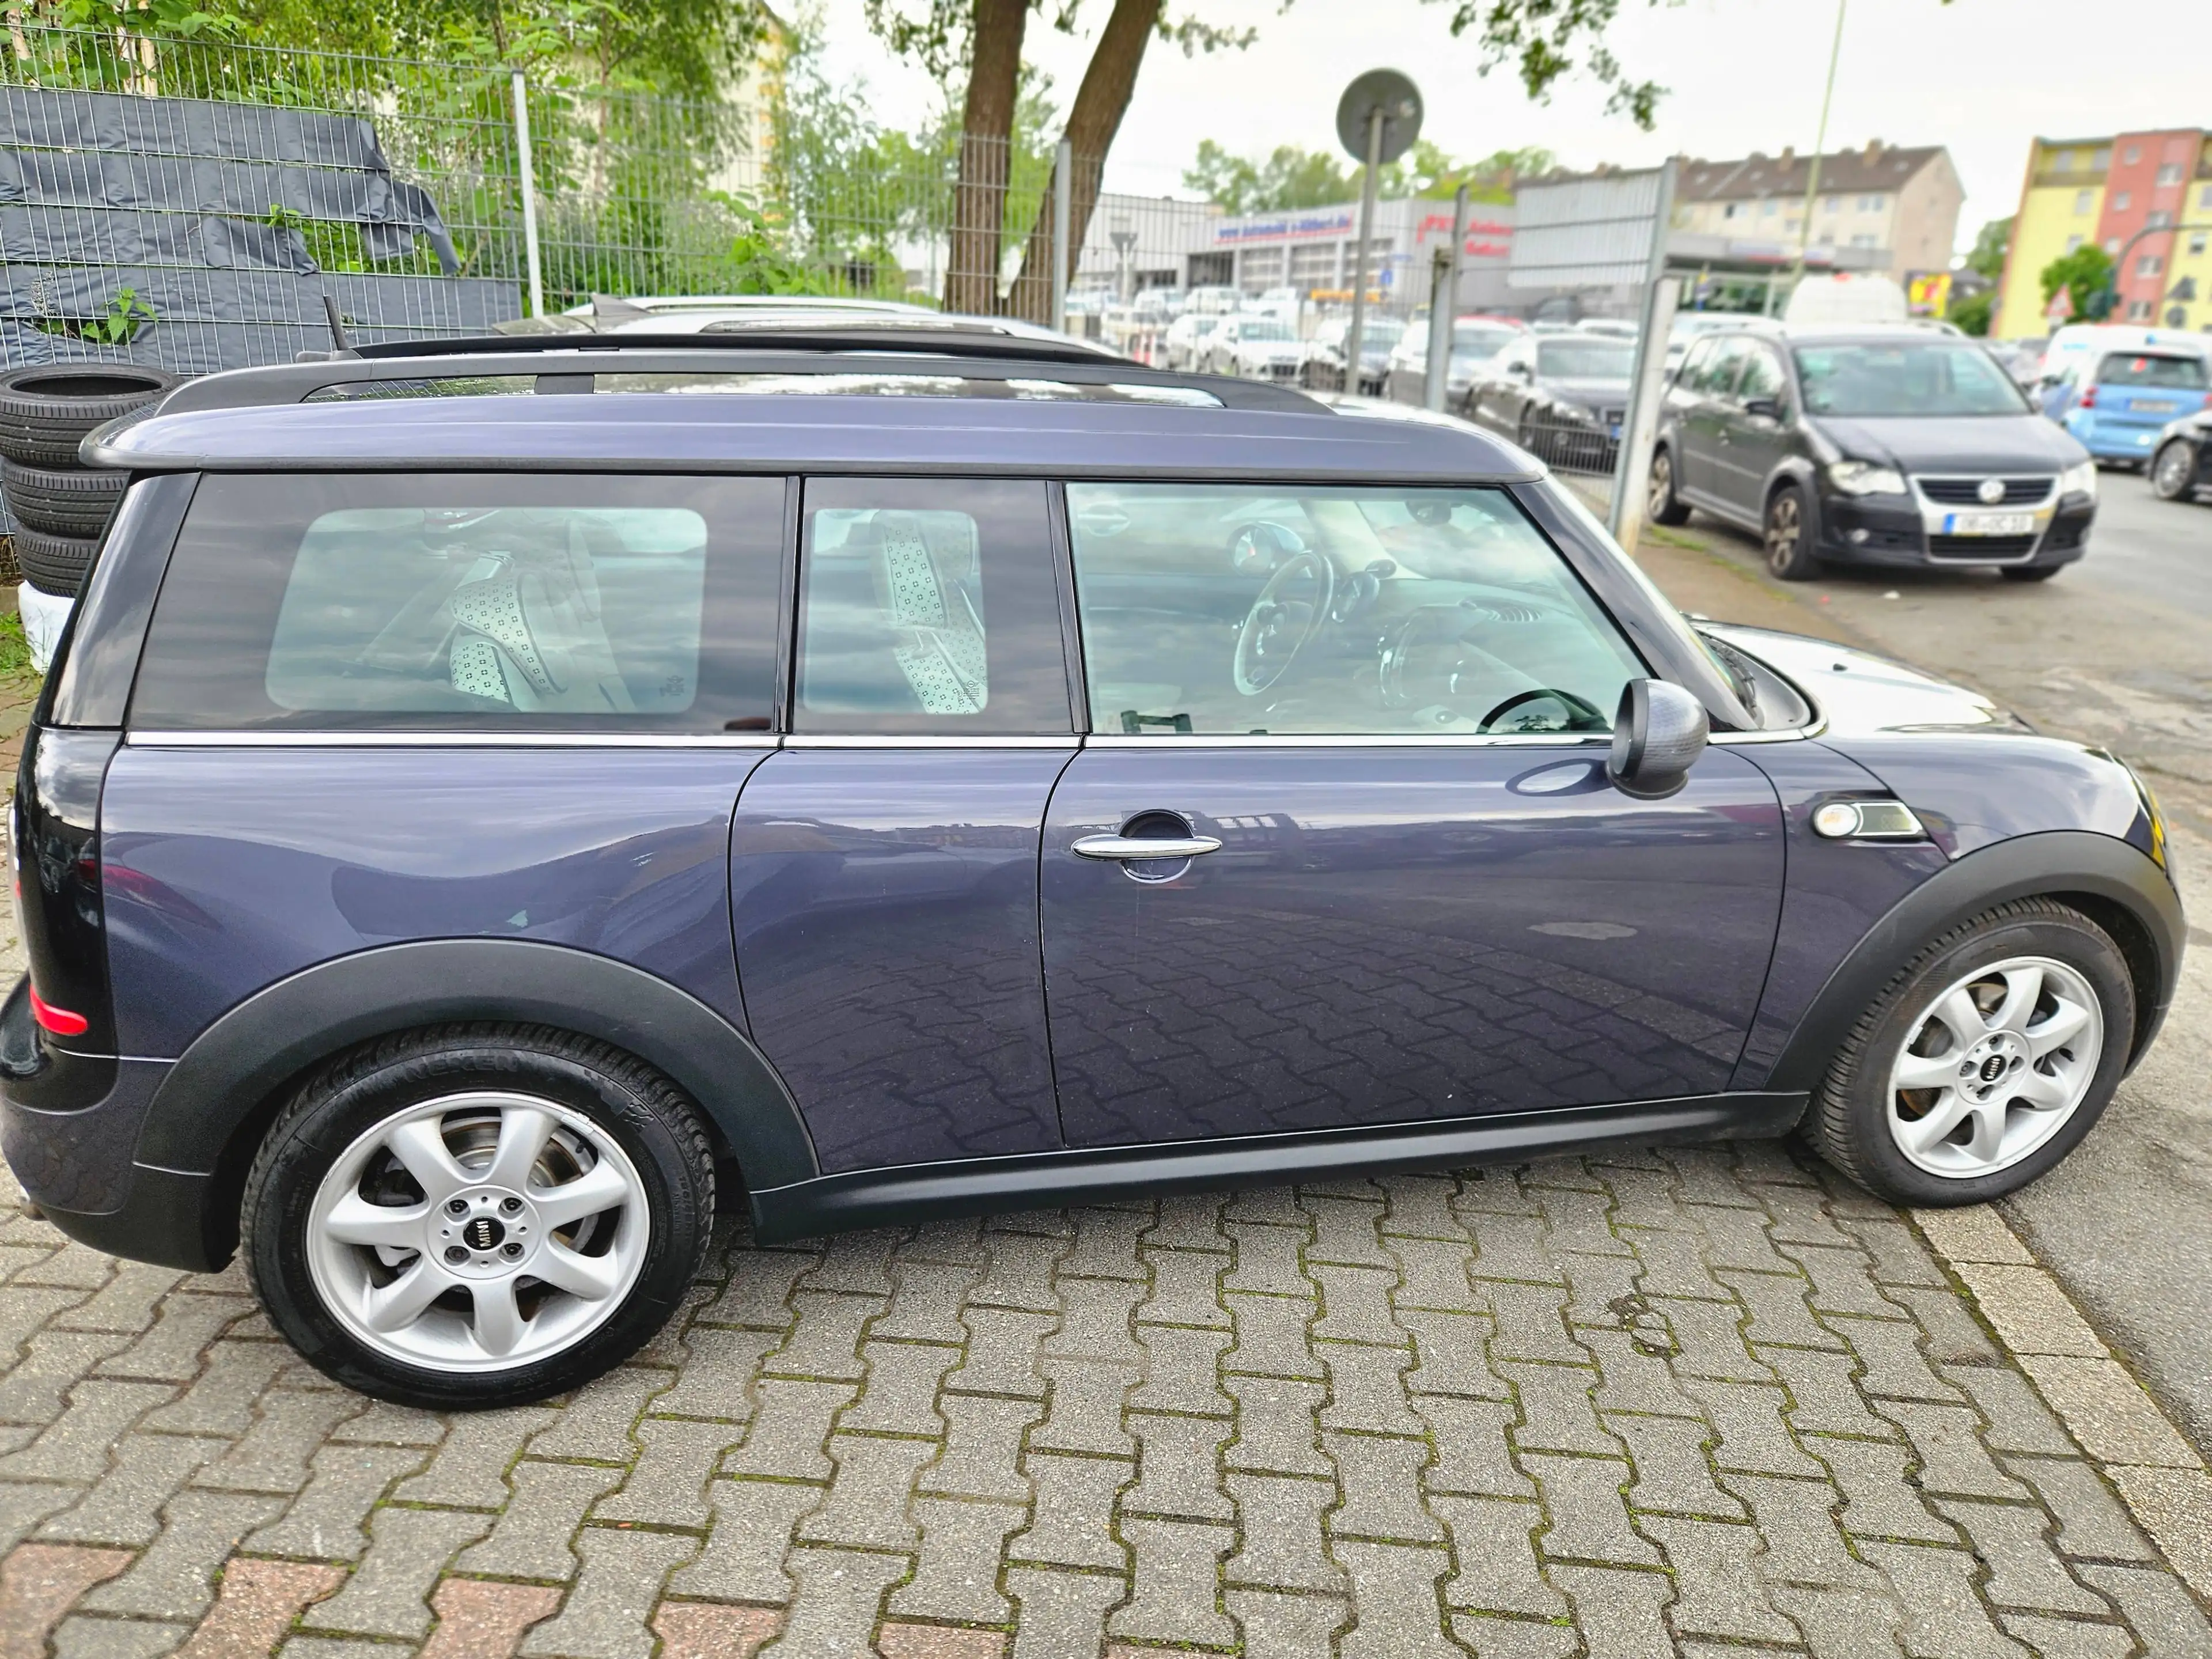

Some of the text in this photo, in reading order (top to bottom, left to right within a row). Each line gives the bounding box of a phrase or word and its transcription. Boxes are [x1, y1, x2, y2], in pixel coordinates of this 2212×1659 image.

[404, 1055, 519, 1082] NEXEN
[1986, 1058, 2001, 1079] MINI
[476, 1221, 491, 1248] MINI
